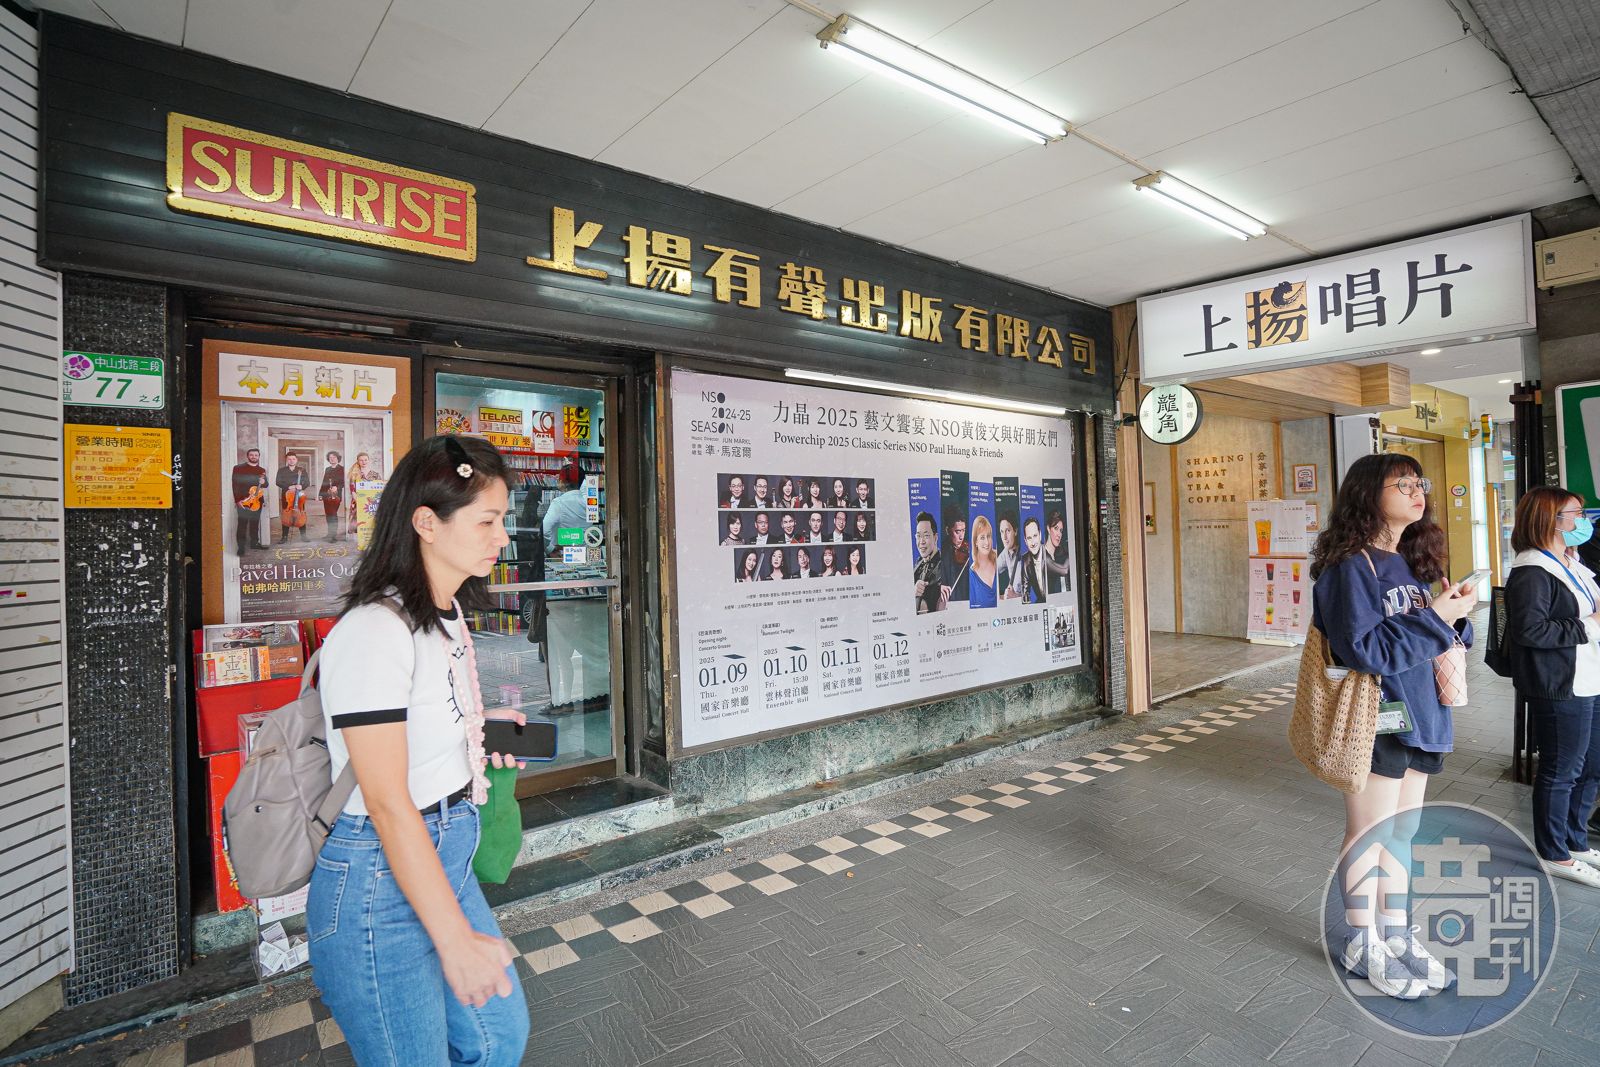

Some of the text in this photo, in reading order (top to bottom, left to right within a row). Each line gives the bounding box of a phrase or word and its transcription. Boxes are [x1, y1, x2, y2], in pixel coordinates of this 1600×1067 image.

[190, 140, 462, 242] SUNRISE
[526, 205, 1097, 376] 上揚有聲出版有限公司
[1183, 254, 1473, 358] 上揚唱片
[94, 357, 161, 372] 中山北路二段
[95, 377, 133, 399] 77
[238, 360, 378, 401] 本月新片
[480, 412, 521, 423] TELARC
[772, 400, 810, 425] 力晶
[816, 406, 858, 428] 2025
[863, 409, 926, 436] 藝文饗宴
[1157, 393, 1179, 434] 龍角
[691, 420, 734, 434] SEASON
[75, 435, 133, 448] 營業時間
[488, 434, 532, 447] 世界音樂
[563, 438, 591, 447] SUNRISE
[773, 431, 1004, 459] Powerchip 2025 Classic Series NSO Paul Huang & Friends
[1186, 454, 1244, 465] SHARING
[1187, 469, 1227, 479] GREAT
[1257, 452, 1268, 501] 分享·好茶
[76, 485, 91, 493] 2F
[1187, 482, 1224, 491] TEA &
[1188, 494, 1236, 504] COFFEE
[283, 564, 326, 580] Haas
[242, 581, 326, 595] 帕弗哈斯四重奏
[821, 640, 835, 648] 2025
[873, 639, 909, 661] 01.12
[763, 648, 778, 656] 2025
[821, 646, 861, 669] 01.11
[699, 656, 715, 665] 2025
[763, 653, 808, 678] 01.10
[699, 662, 748, 688] 01.09
[822, 666, 862, 679] Sat. 19:30
[874, 667, 910, 682] 國家音樂廳
[765, 675, 809, 689] Fri. 15:30
[823, 675, 862, 692] 國家音樂廳
[700, 685, 749, 700] Thu. 19:30
[701, 695, 749, 714] 國家音樂廳
[766, 696, 809, 709] Ensemble Hall
[701, 713, 721, 721] National
[721, 710, 739, 718] Concert
